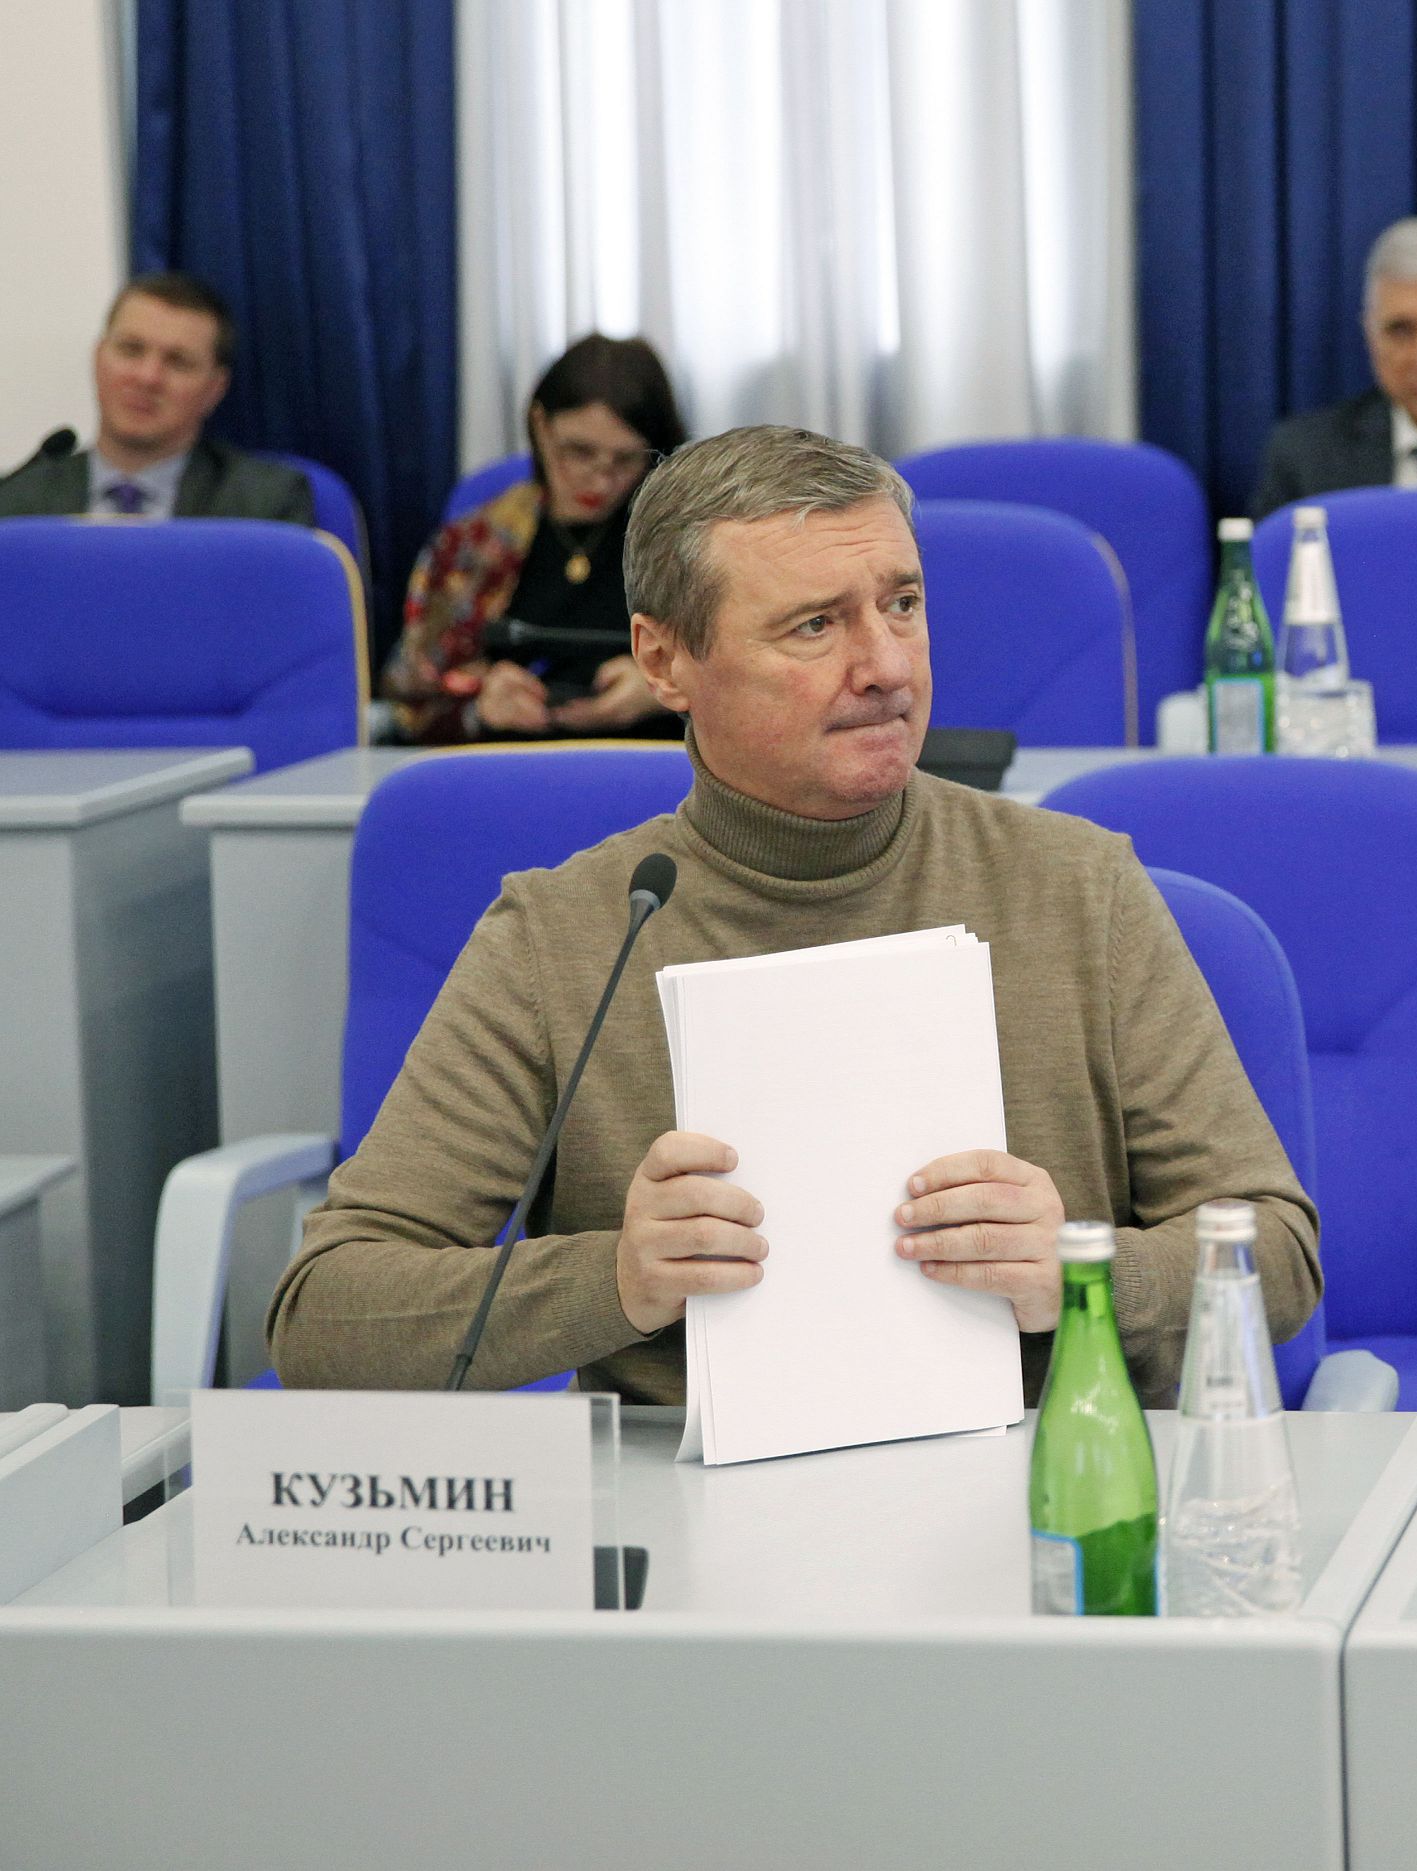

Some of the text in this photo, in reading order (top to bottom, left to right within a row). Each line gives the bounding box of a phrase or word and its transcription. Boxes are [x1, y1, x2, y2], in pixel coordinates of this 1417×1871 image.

[271, 1471, 515, 1513] КУЗЬМИН
[235, 1523, 552, 1558] Александр Сергеевич
